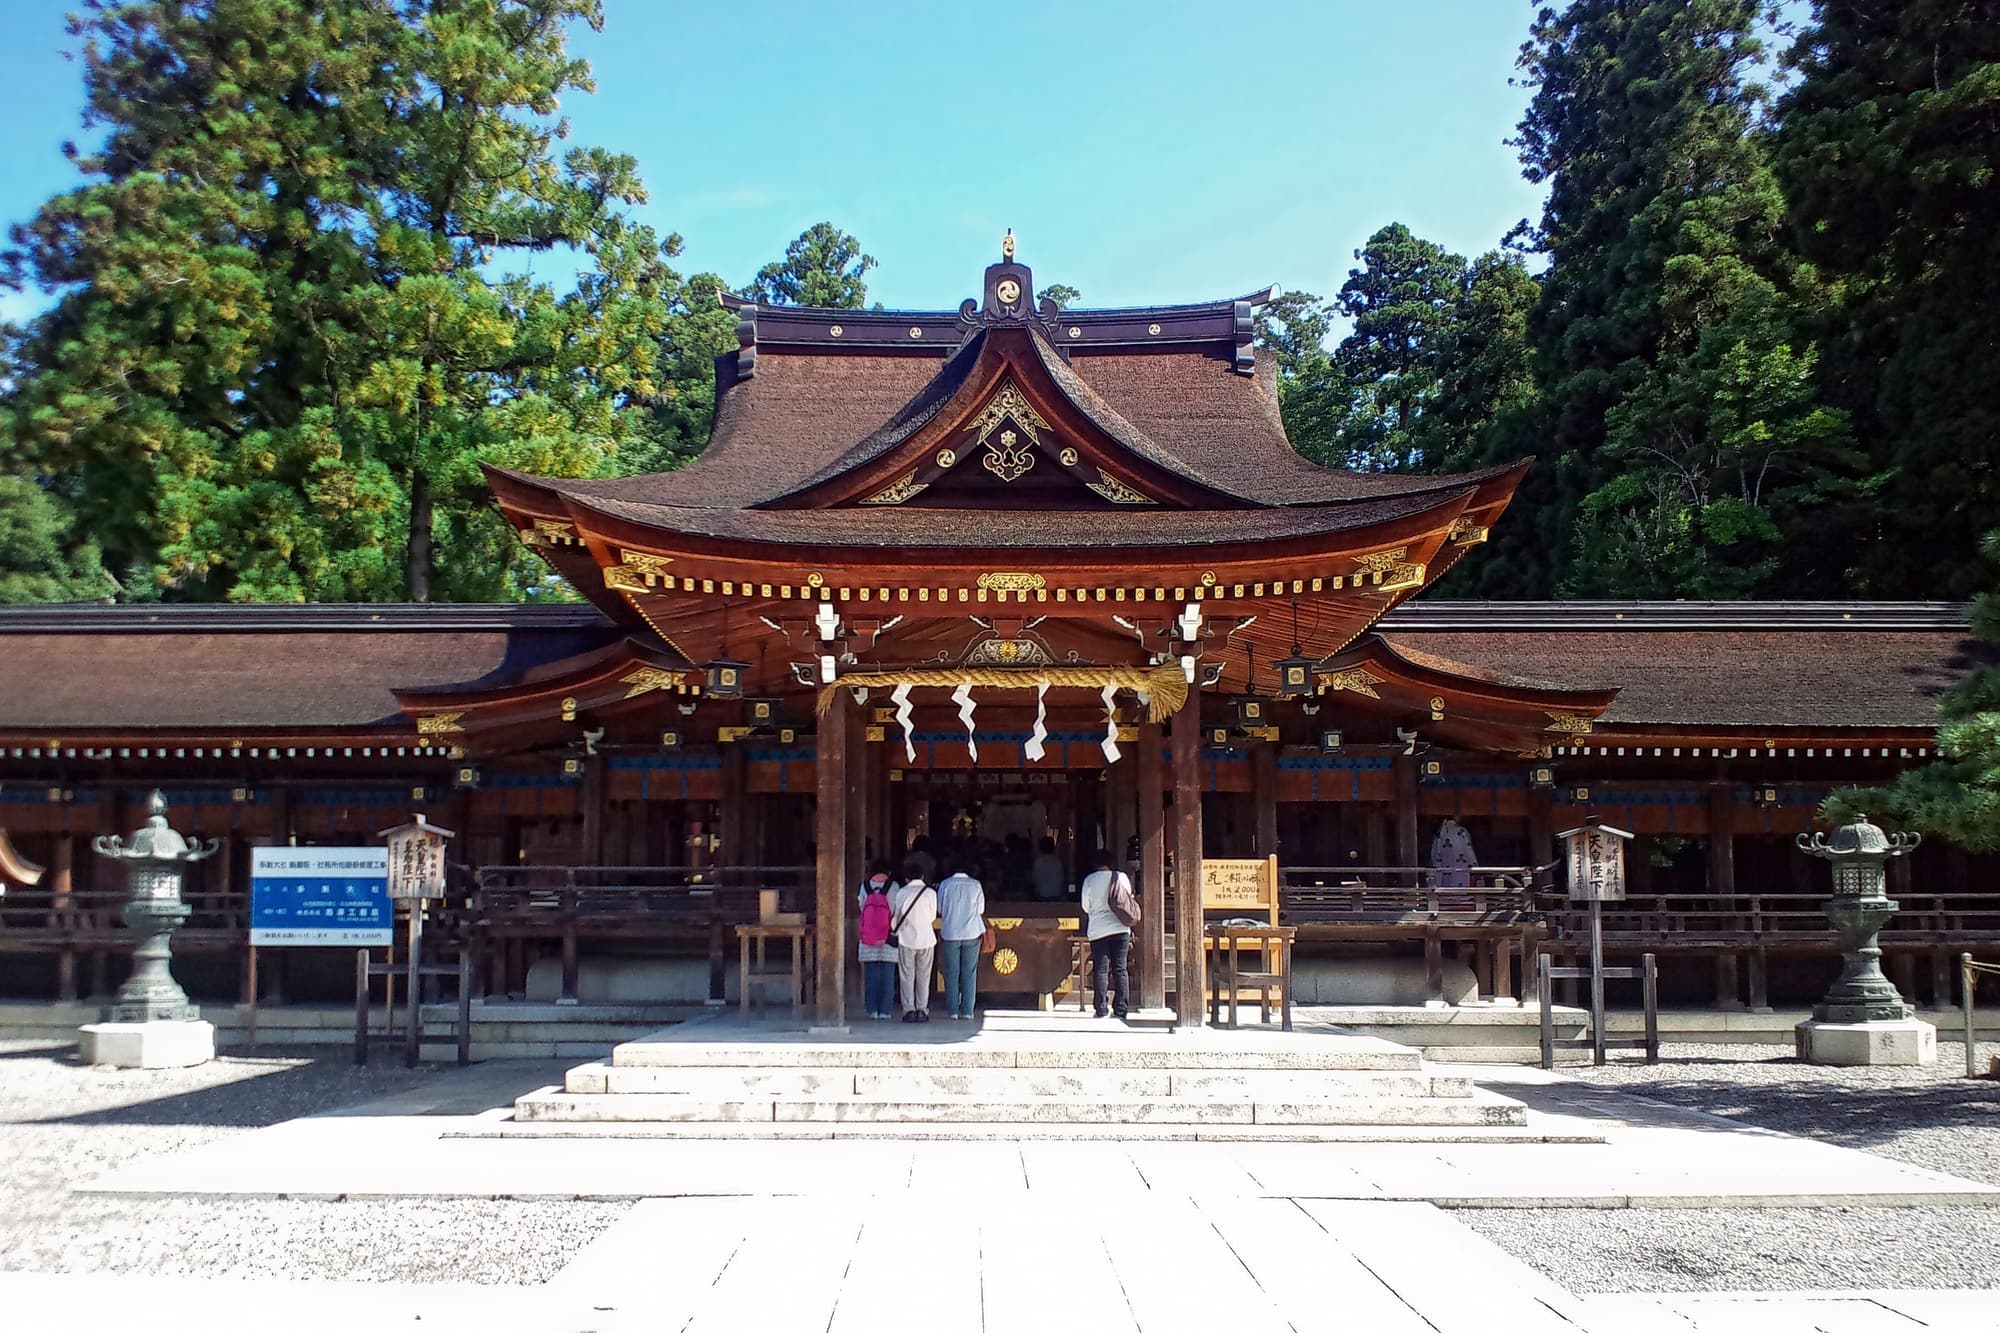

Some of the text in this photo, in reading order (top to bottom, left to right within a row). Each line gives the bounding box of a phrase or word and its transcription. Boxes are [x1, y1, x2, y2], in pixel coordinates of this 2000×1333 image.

[402, 839, 413, 889] 皇后陛下
[416, 838, 428, 889] 天皇陛下
[1589, 834, 1604, 895] 天皇陛下
